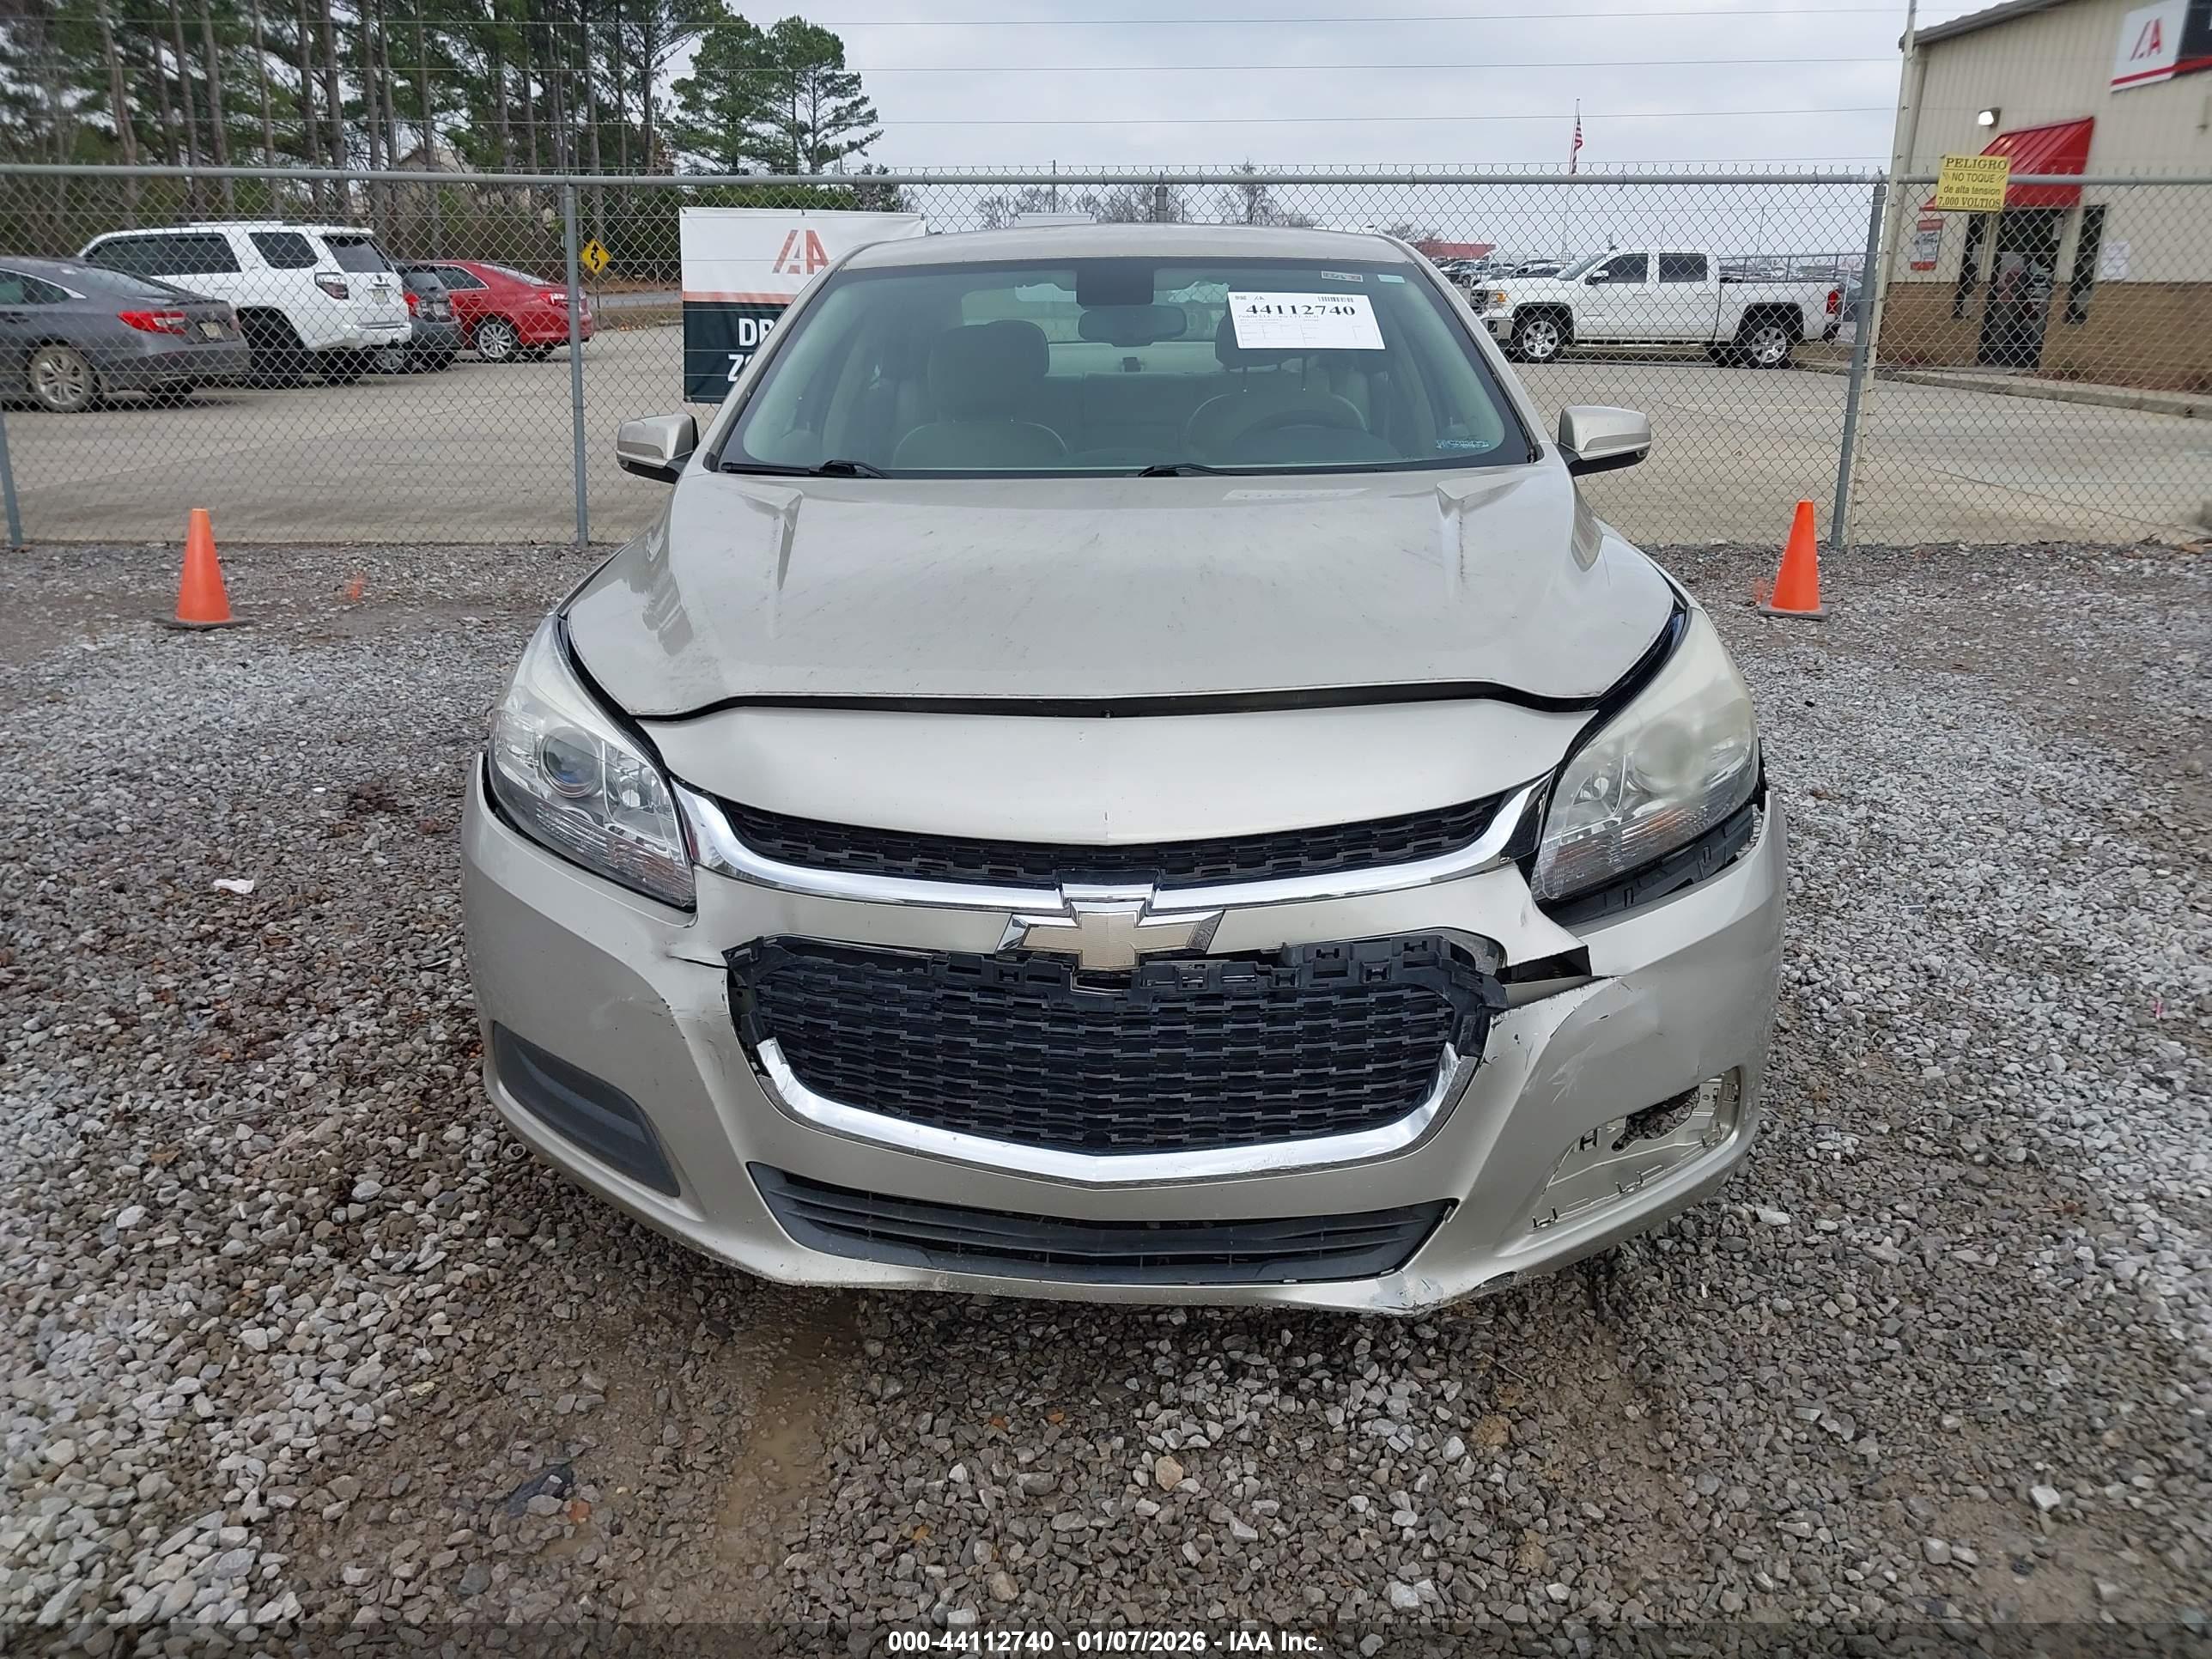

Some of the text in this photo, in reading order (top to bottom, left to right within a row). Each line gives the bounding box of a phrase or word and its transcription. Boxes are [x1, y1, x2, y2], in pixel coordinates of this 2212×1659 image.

[1944, 157, 2007, 170] PELIGRO
[1951, 172, 1996, 183] NO TOQUE
[1943, 185, 1954, 194] de
[1954, 185, 1970, 194] alta
[1938, 196, 2002, 208] 7,000 VOLTIOS
[1245, 304, 1356, 316] 44112740
[727, 353, 752, 382] Z
